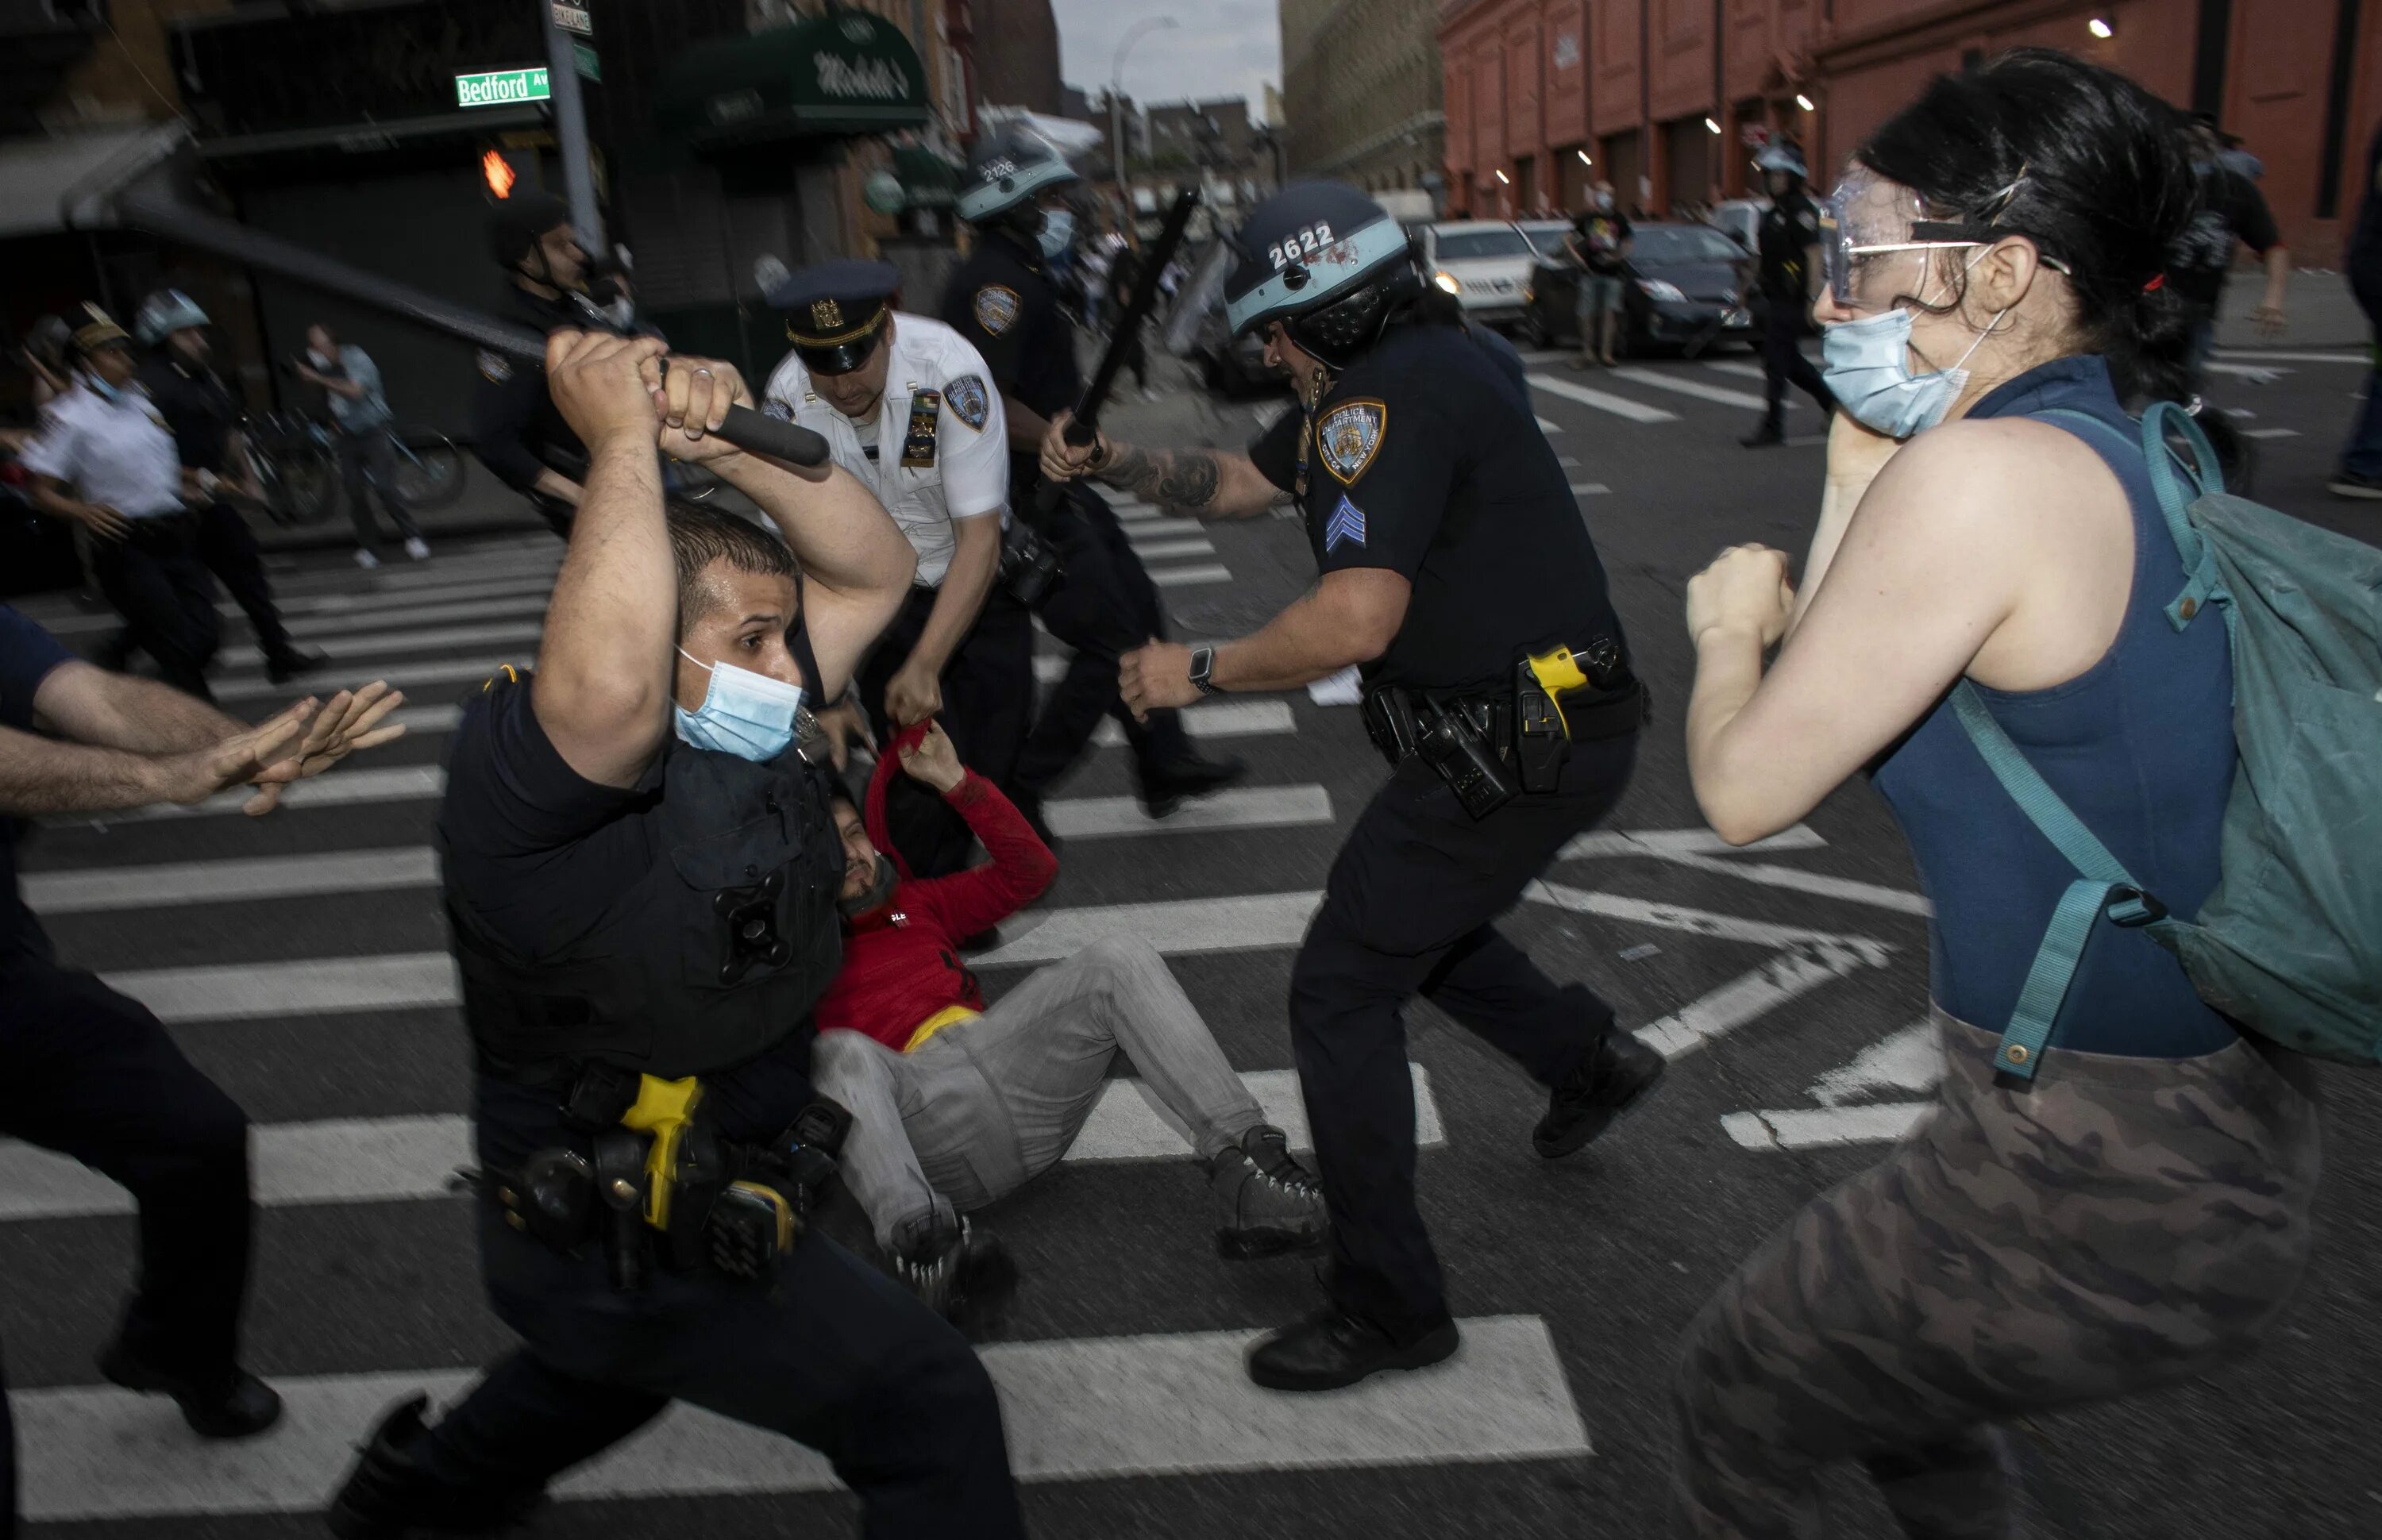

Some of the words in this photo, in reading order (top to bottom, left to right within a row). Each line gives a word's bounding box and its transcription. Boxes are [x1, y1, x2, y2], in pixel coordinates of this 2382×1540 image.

[458, 73, 528, 102] Bedford
[985, 161, 1014, 182] 2126
[1269, 225, 1334, 270] 2622
[954, 406, 965, 419] CITY
[1334, 408, 1365, 421] POLICE
[1322, 415, 1377, 435] DEPARTMENT
[1321, 444, 1333, 461] CITY
[1331, 460, 1341, 471] OF
[1351, 452, 1367, 470] NEW
[1364, 429, 1379, 452] YORK
